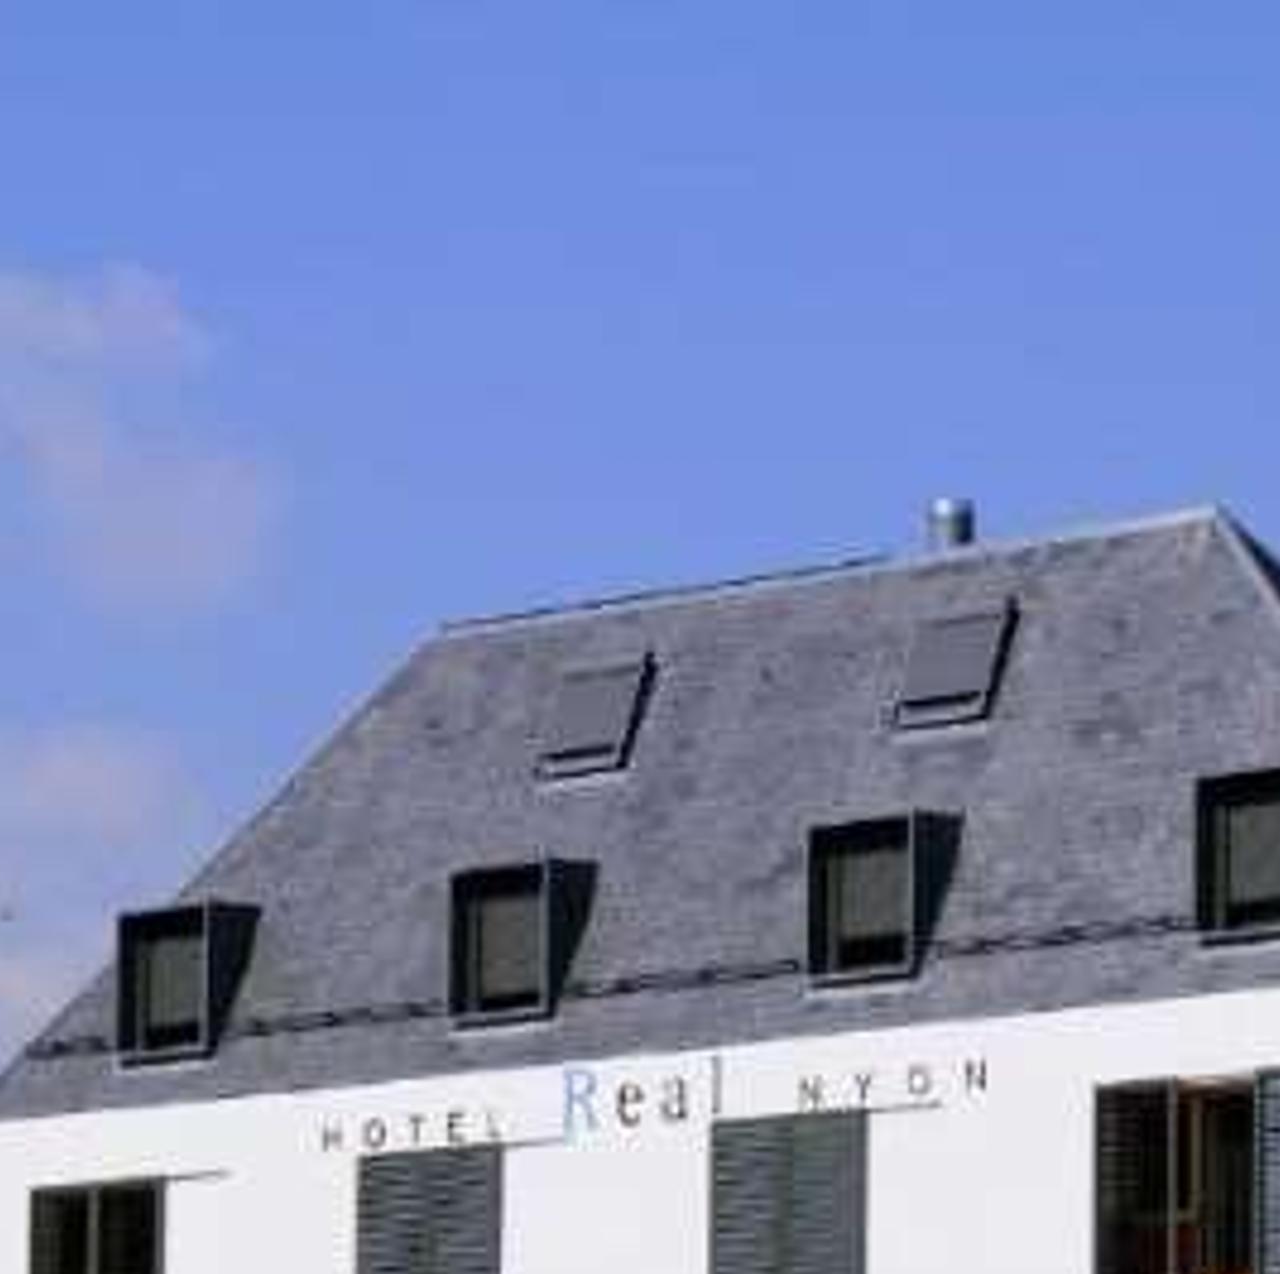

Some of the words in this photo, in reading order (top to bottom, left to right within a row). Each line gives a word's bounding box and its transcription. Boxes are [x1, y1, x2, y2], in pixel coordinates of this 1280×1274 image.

[322, 1110, 505, 1152] HOTEL
[563, 1055, 722, 1144] Real
[798, 1059, 987, 1112] NYON
